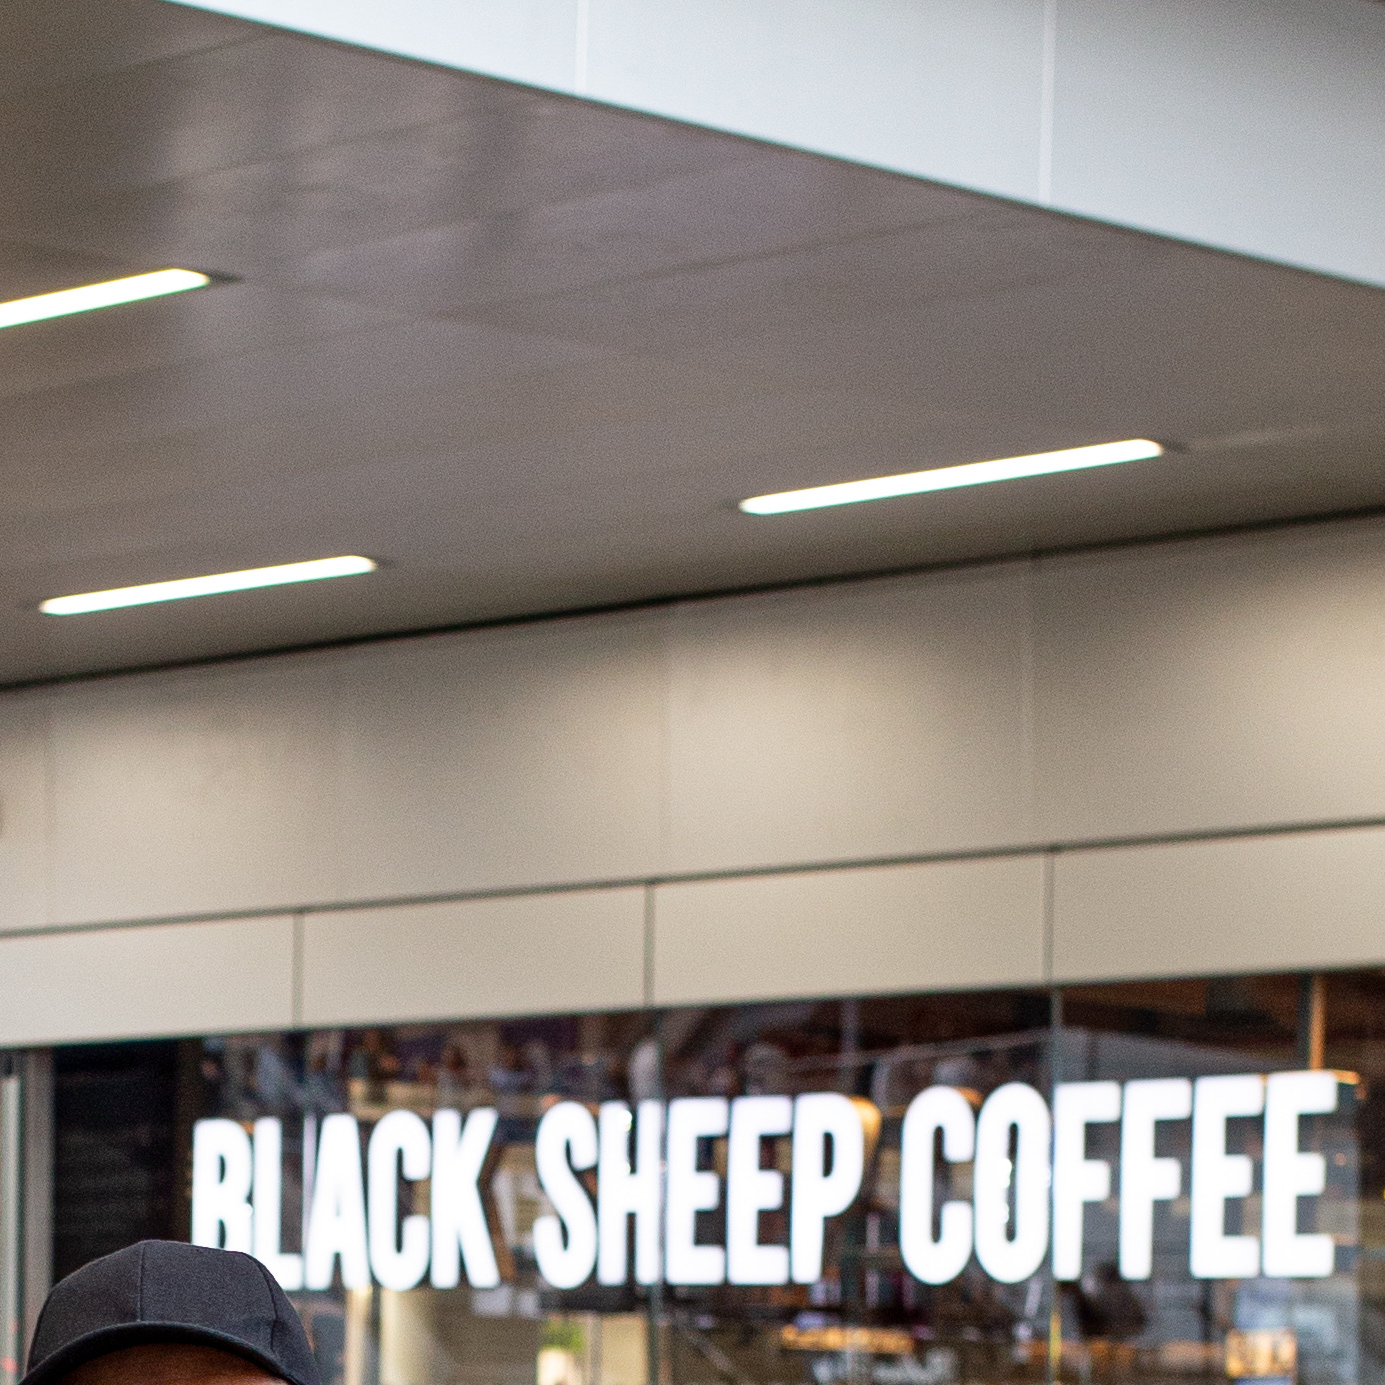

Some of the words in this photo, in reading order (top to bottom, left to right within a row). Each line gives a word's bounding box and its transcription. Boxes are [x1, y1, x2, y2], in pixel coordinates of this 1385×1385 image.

[191, 1107, 500, 1292] BLACK
[533, 1094, 864, 1290] SHEEP
[899, 1070, 1339, 1286] COFFEE
